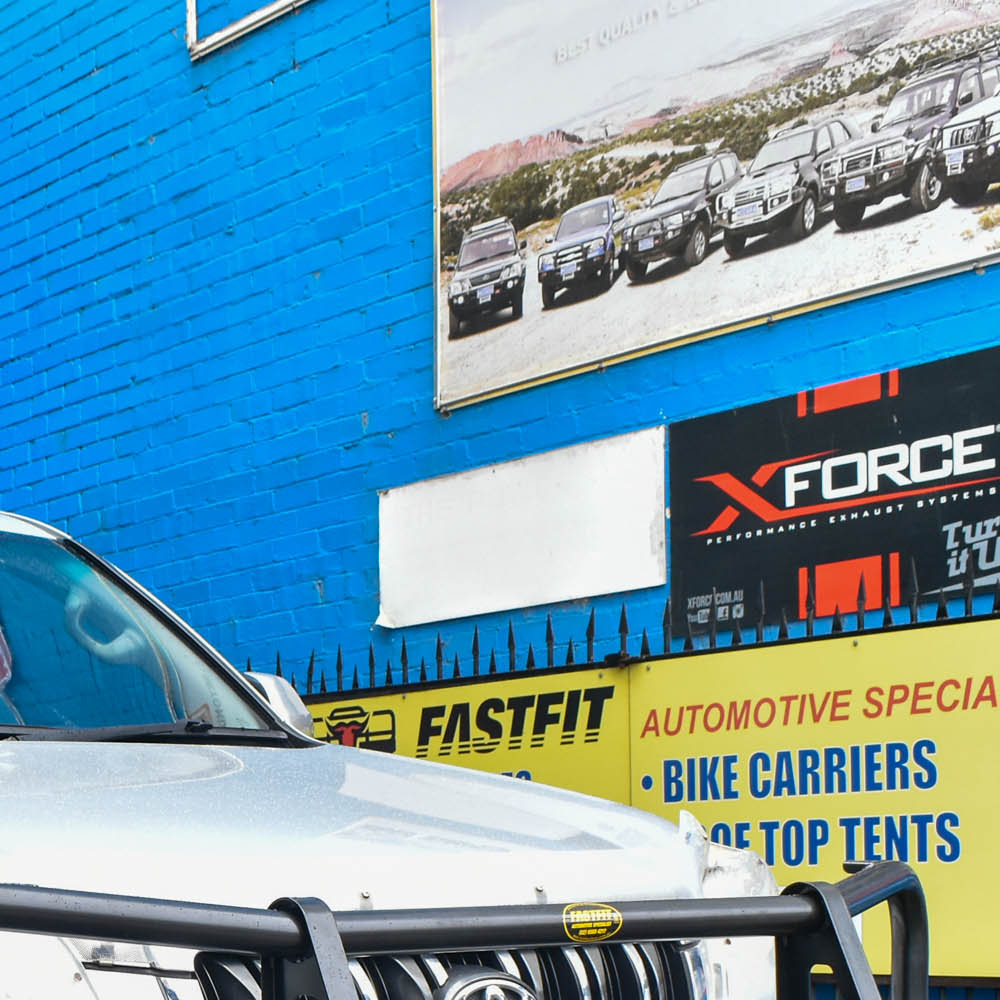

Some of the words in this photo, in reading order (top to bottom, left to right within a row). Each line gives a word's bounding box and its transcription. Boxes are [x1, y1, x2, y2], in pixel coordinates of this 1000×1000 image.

[690, 424, 996, 537] XFORCE
[706, 519, 818, 546] PERFORMANCE
[828, 503, 905, 525] EXHAUST
[916, 486, 997, 508] SYSTEMS
[416, 685, 615, 758] FASTFIT
[640, 689, 853, 738] AUTOMOTIVE
[862, 675, 998, 719] SPECIA
[663, 754, 739, 804] BIKE
[749, 738, 938, 799] CARRIERS
[759, 818, 830, 867] TOP
[839, 811, 961, 864] TENTS
